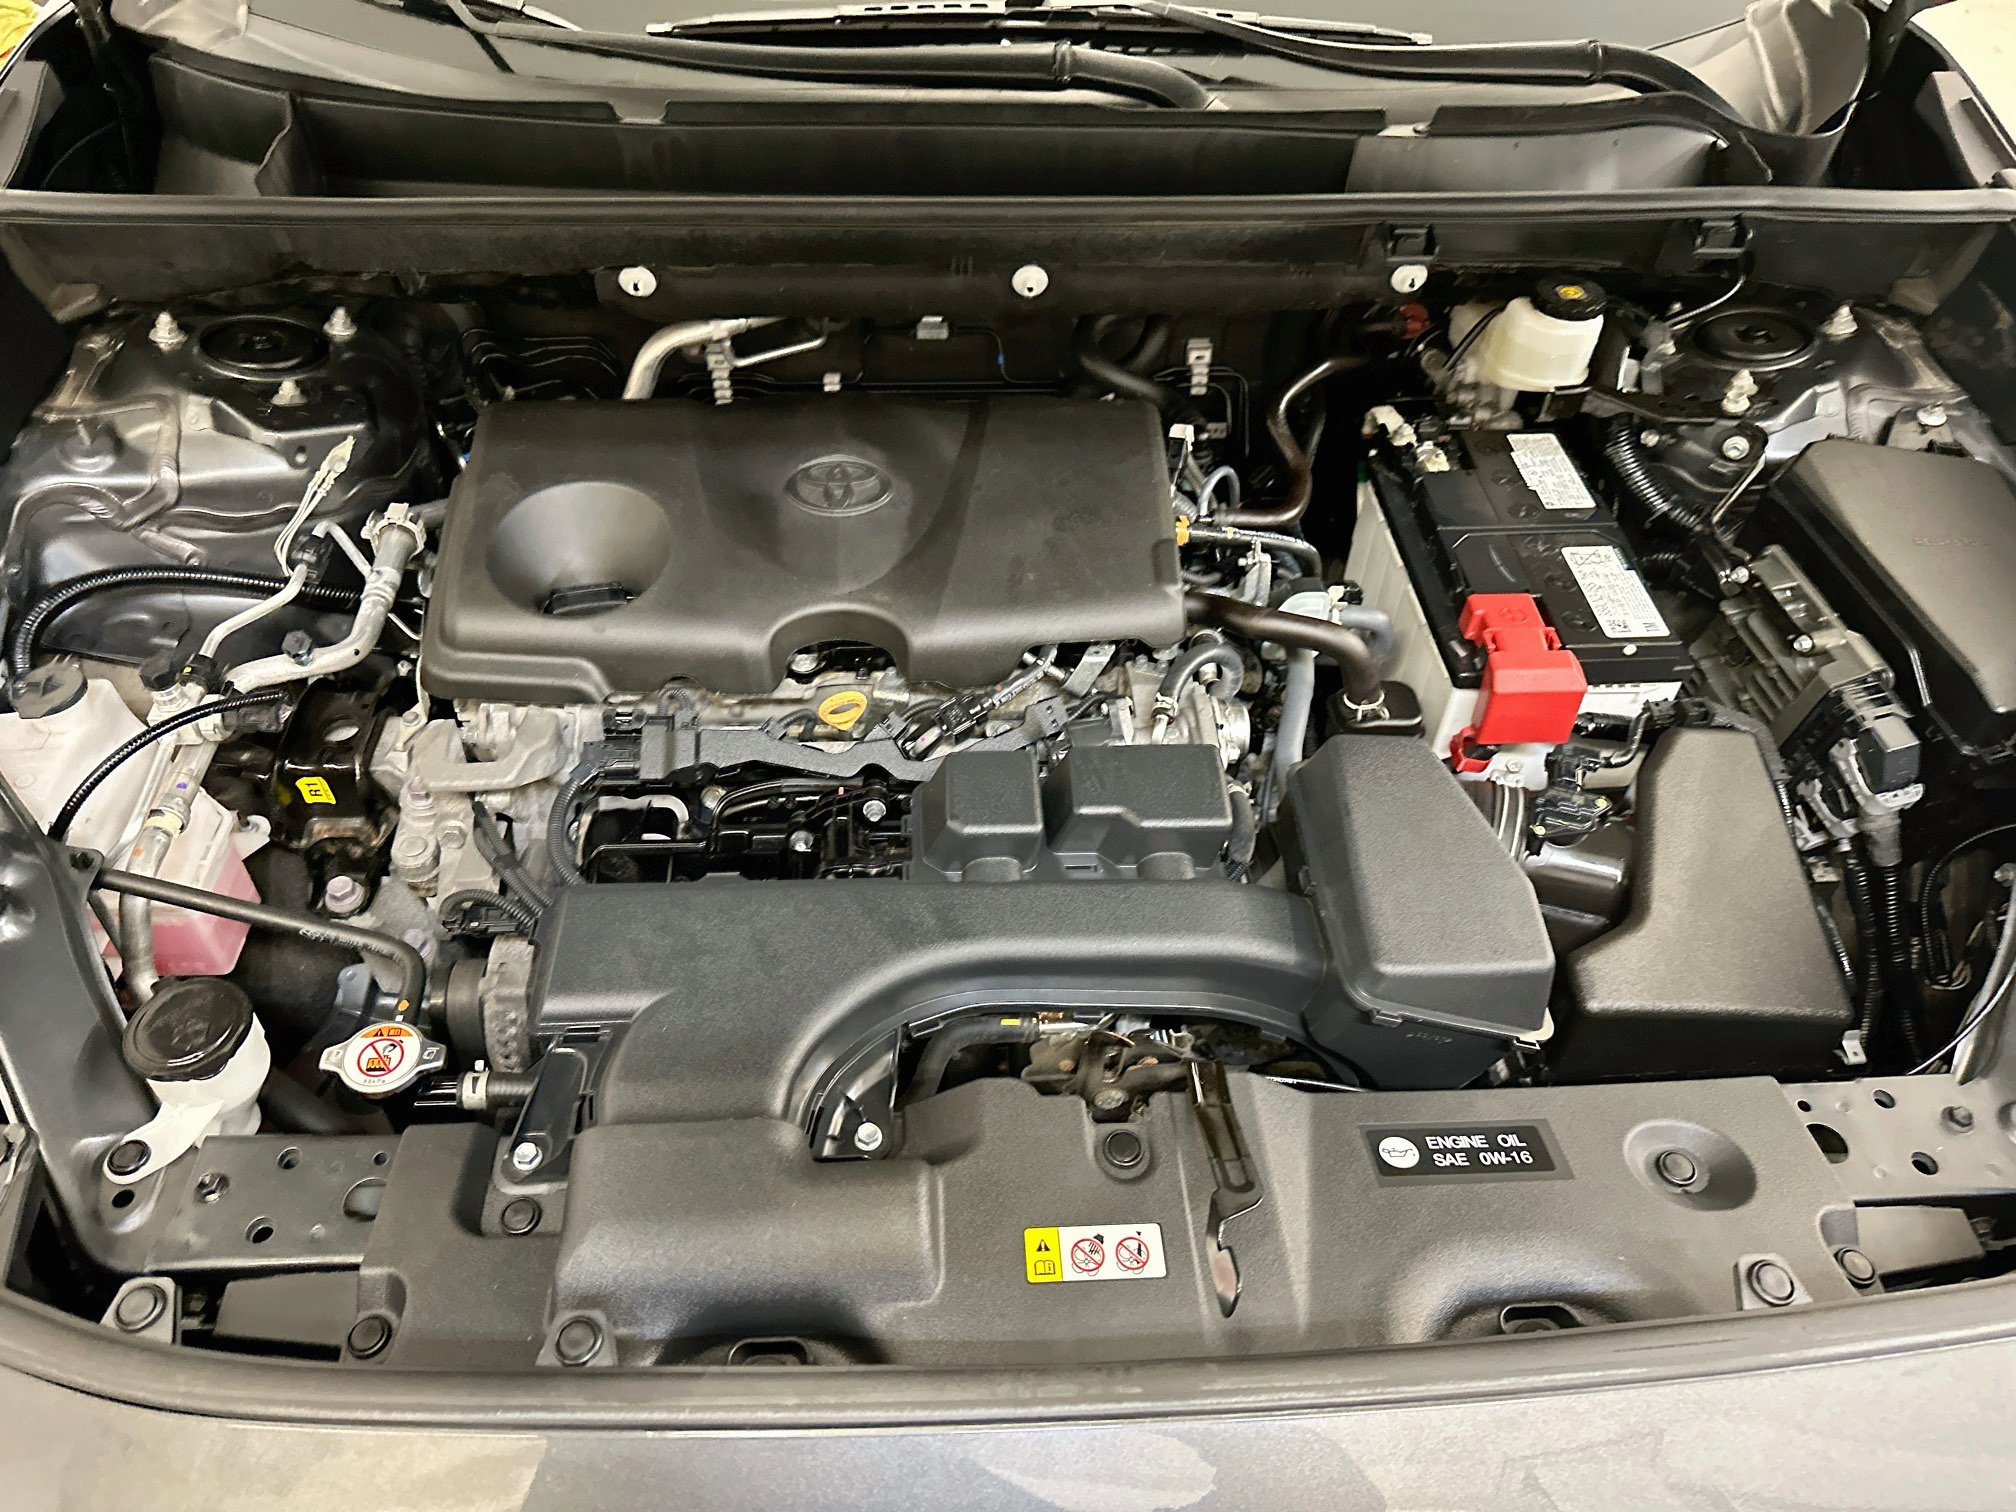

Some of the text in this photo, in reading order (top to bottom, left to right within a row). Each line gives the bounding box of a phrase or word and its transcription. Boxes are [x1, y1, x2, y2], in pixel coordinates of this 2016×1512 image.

[305, 783, 323, 797] R1
[1425, 1133, 1527, 1149] ENGINE OIL
[1432, 1150, 1534, 1167] SAE 0W-16
